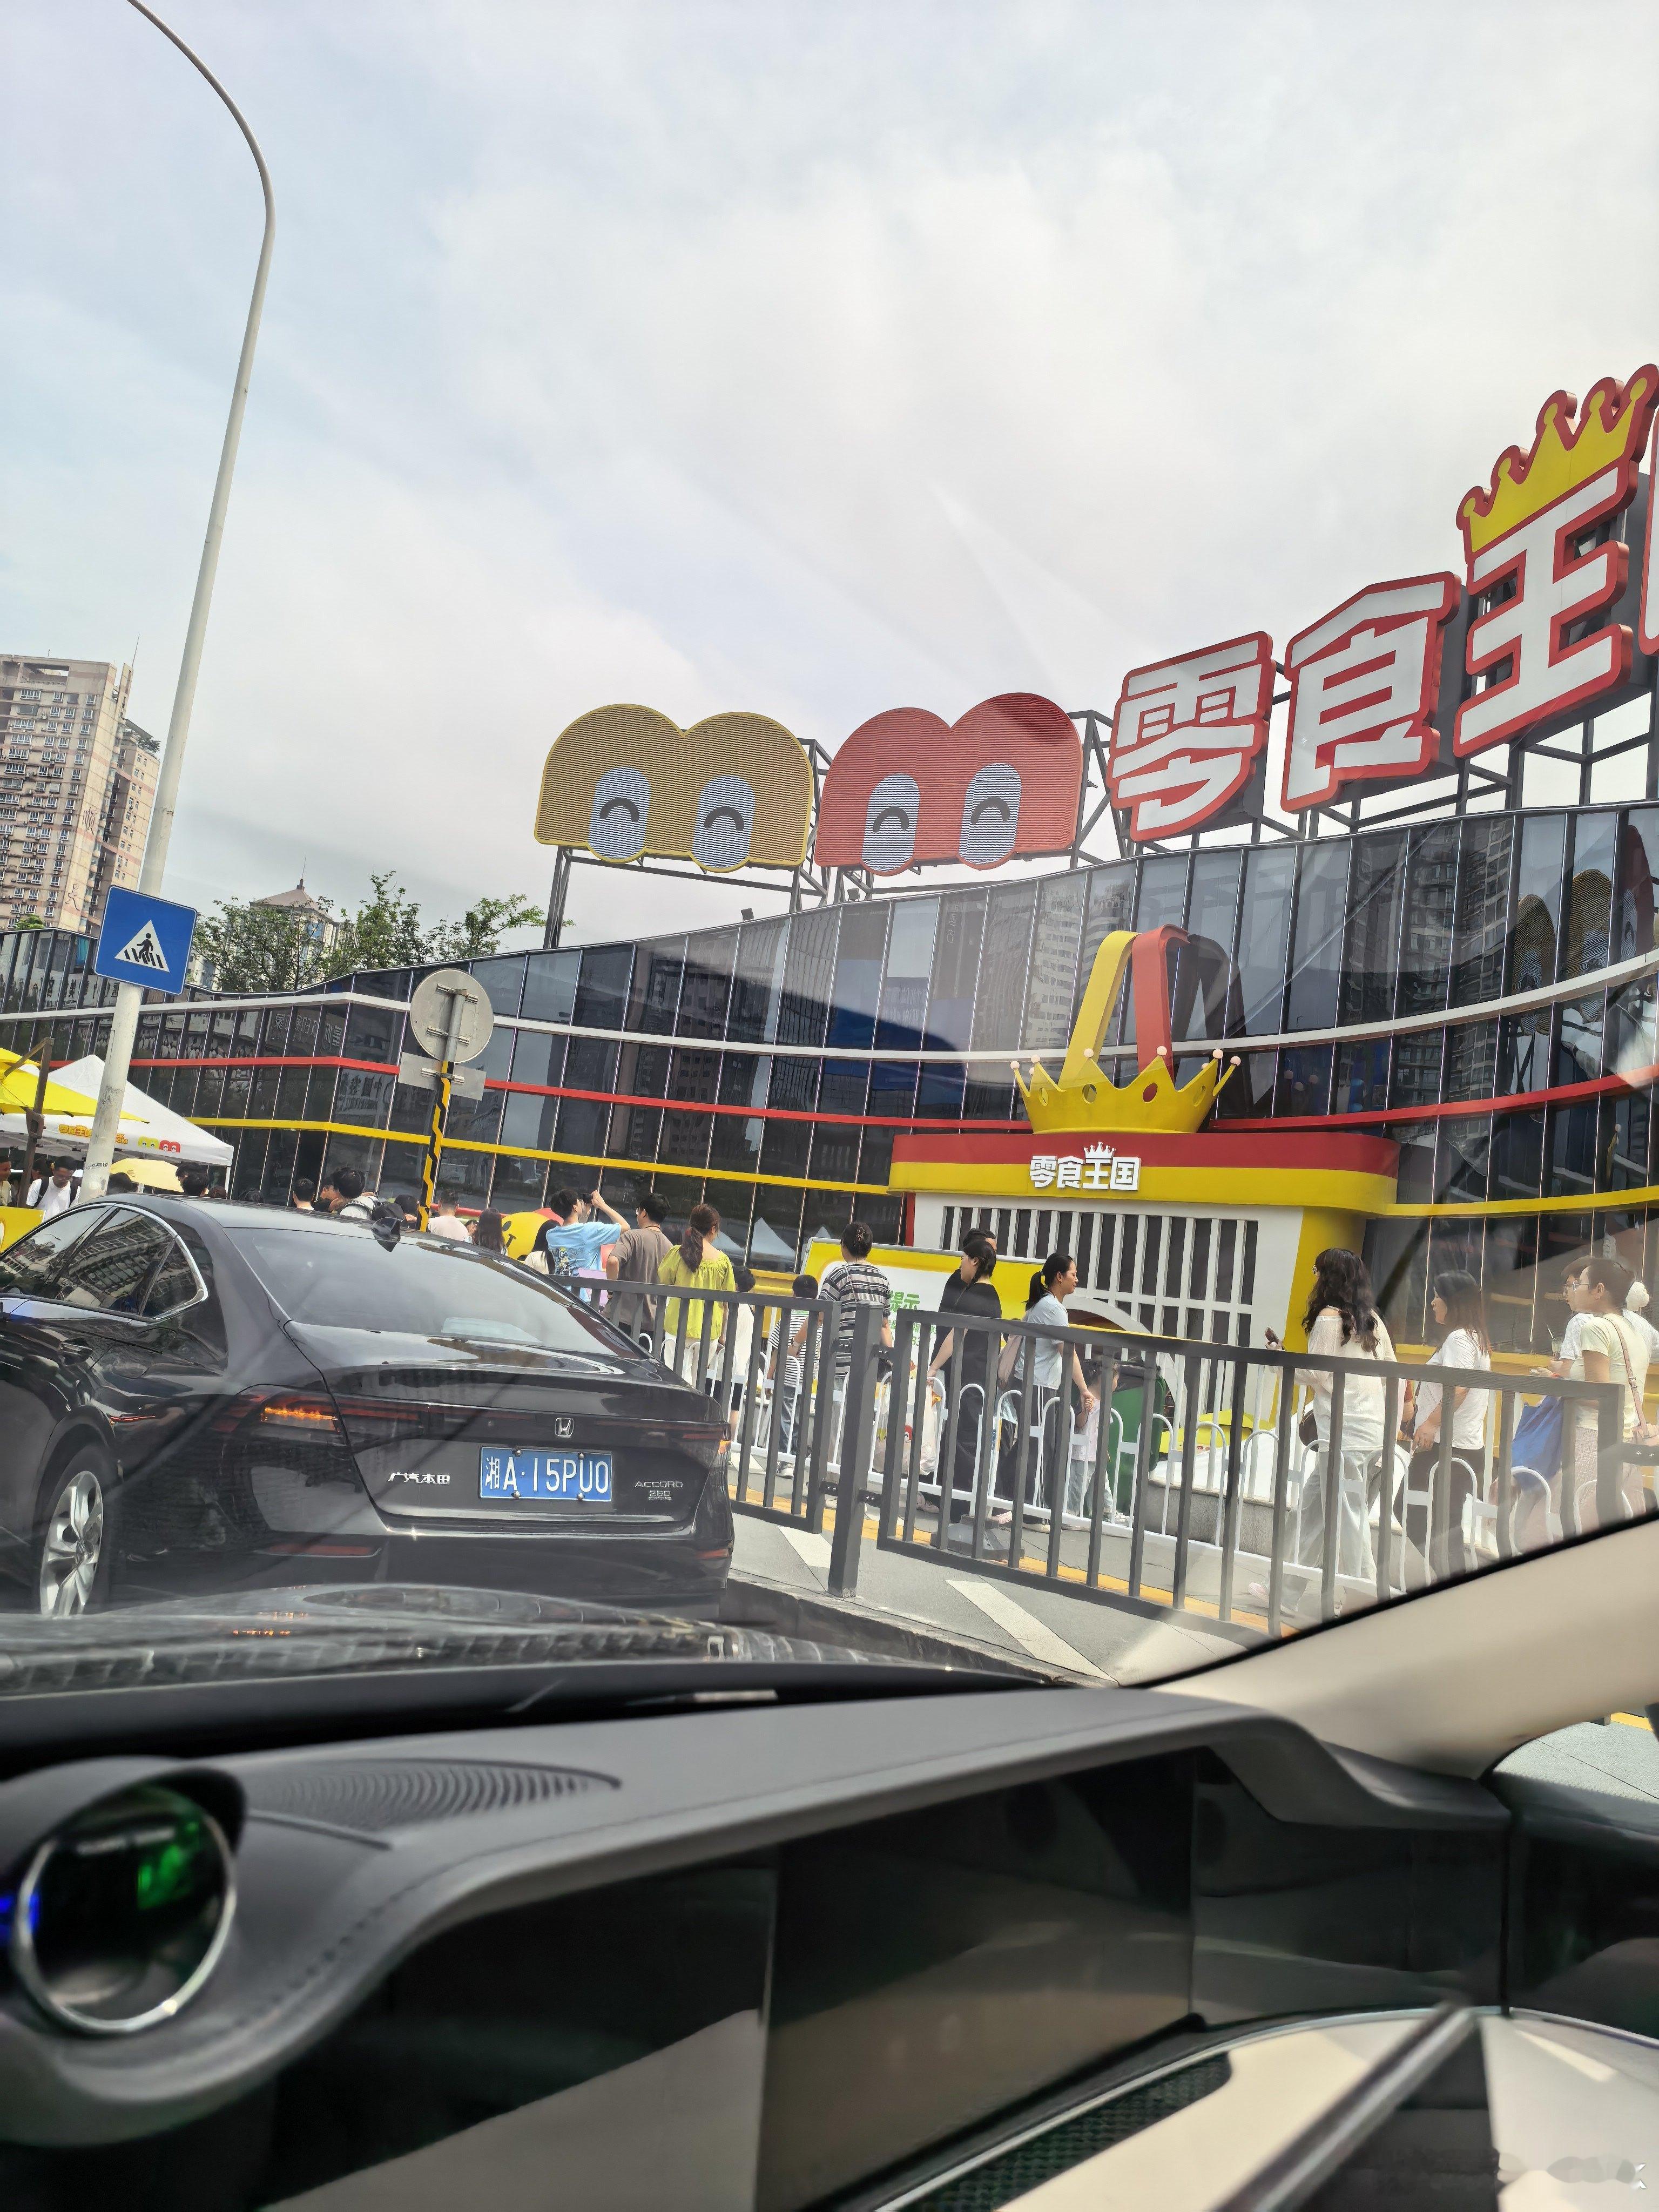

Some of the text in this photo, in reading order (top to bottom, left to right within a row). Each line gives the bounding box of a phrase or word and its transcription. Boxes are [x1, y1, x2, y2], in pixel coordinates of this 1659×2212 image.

[1107, 459, 1659, 840] 零食王
[1029, 1155, 1142, 1191] 零食王国
[387, 1472, 450, 1484] 广汽本田
